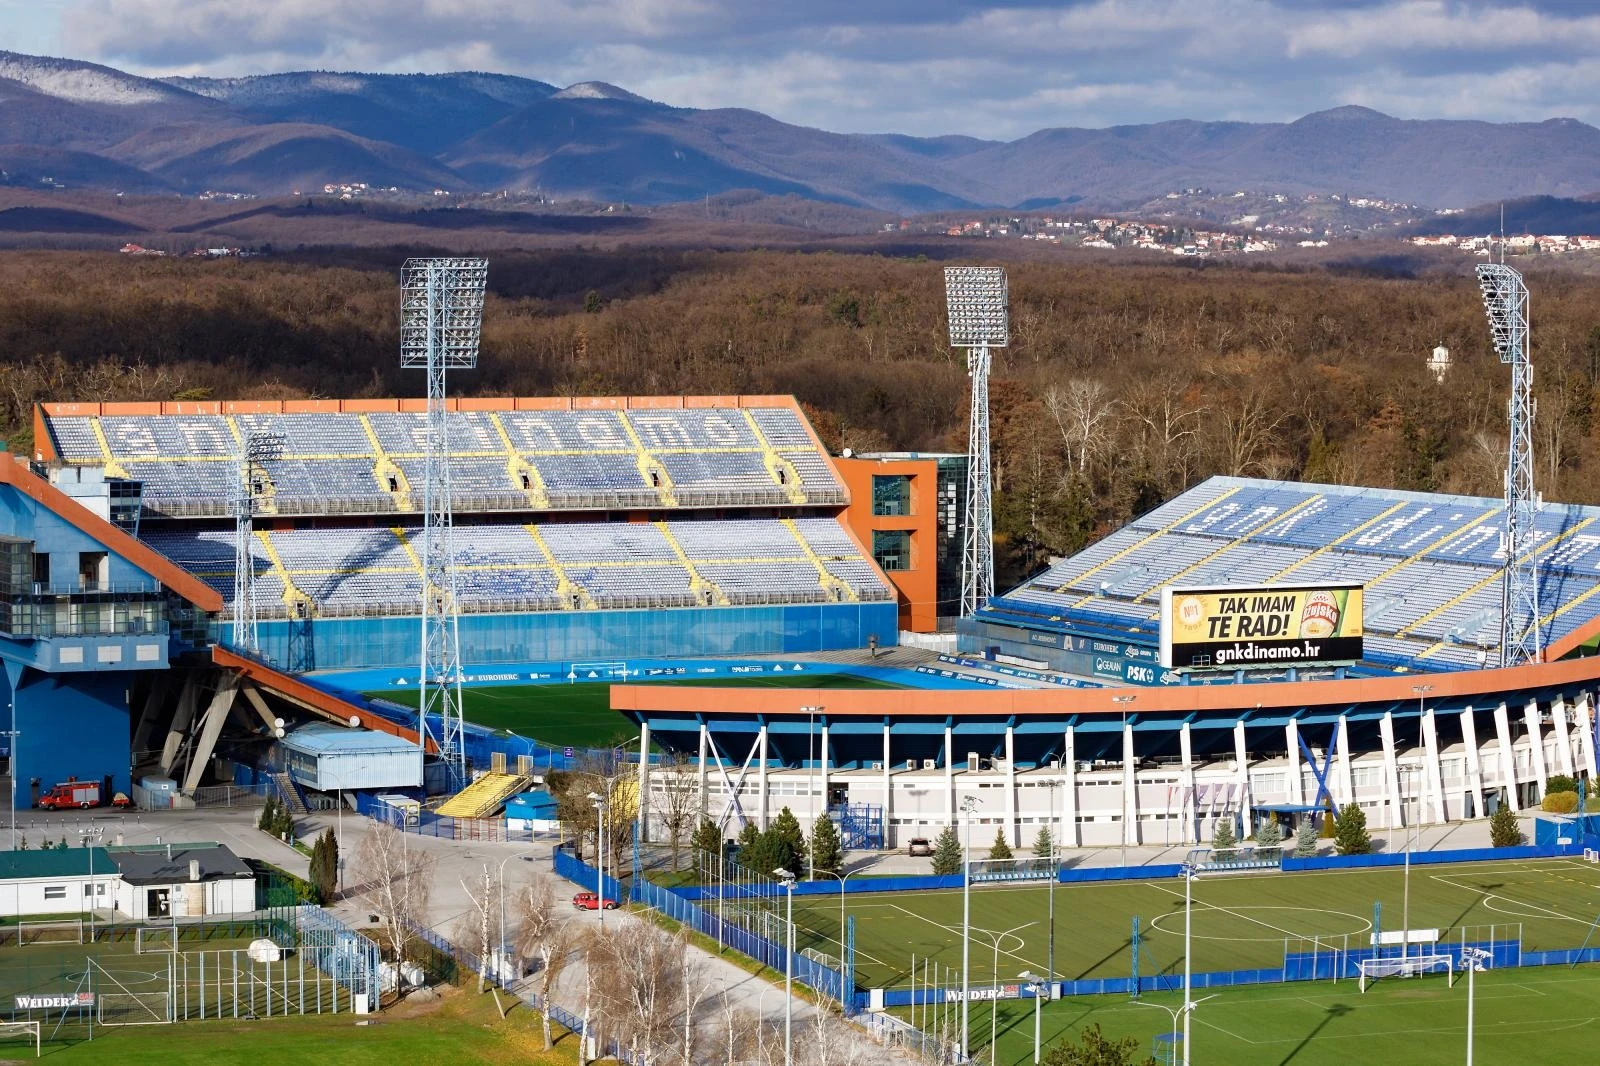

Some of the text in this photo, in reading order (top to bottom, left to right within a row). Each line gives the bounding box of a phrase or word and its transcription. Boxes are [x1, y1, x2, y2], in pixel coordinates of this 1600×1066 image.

[1218, 597, 1248, 614] TAK
[1250, 595, 1297, 613] IMAM
[1207, 614, 1290, 639] TE RAD!
[1216, 641, 1321, 664] gnkdinamo.hr
[478, 673, 518, 681] EUROHERC
[1127, 666, 1146, 682] PSK
[16, 997, 69, 1009] WEIDER
[946, 989, 997, 1001] WEDER
